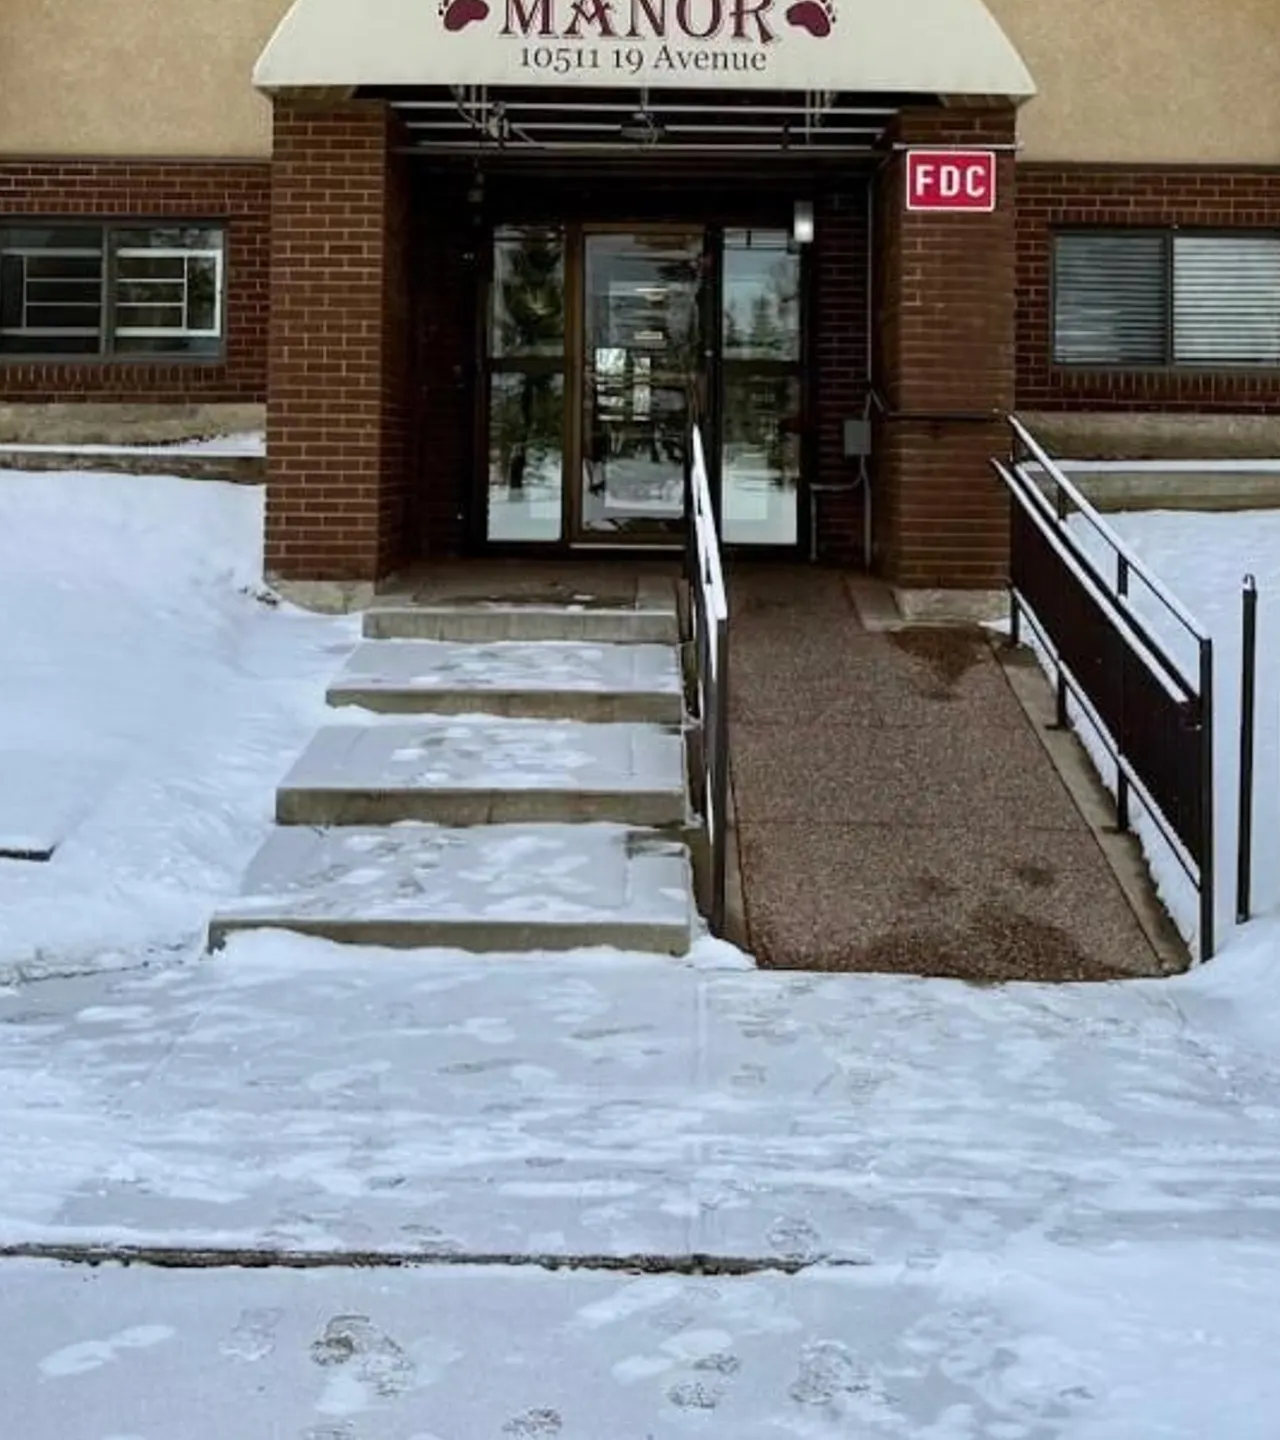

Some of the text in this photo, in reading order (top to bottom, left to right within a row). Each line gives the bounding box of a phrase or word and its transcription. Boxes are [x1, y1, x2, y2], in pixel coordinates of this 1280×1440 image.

[521, 45, 768, 74] 10511 19 Avenue
[915, 164, 986, 198] FDC
